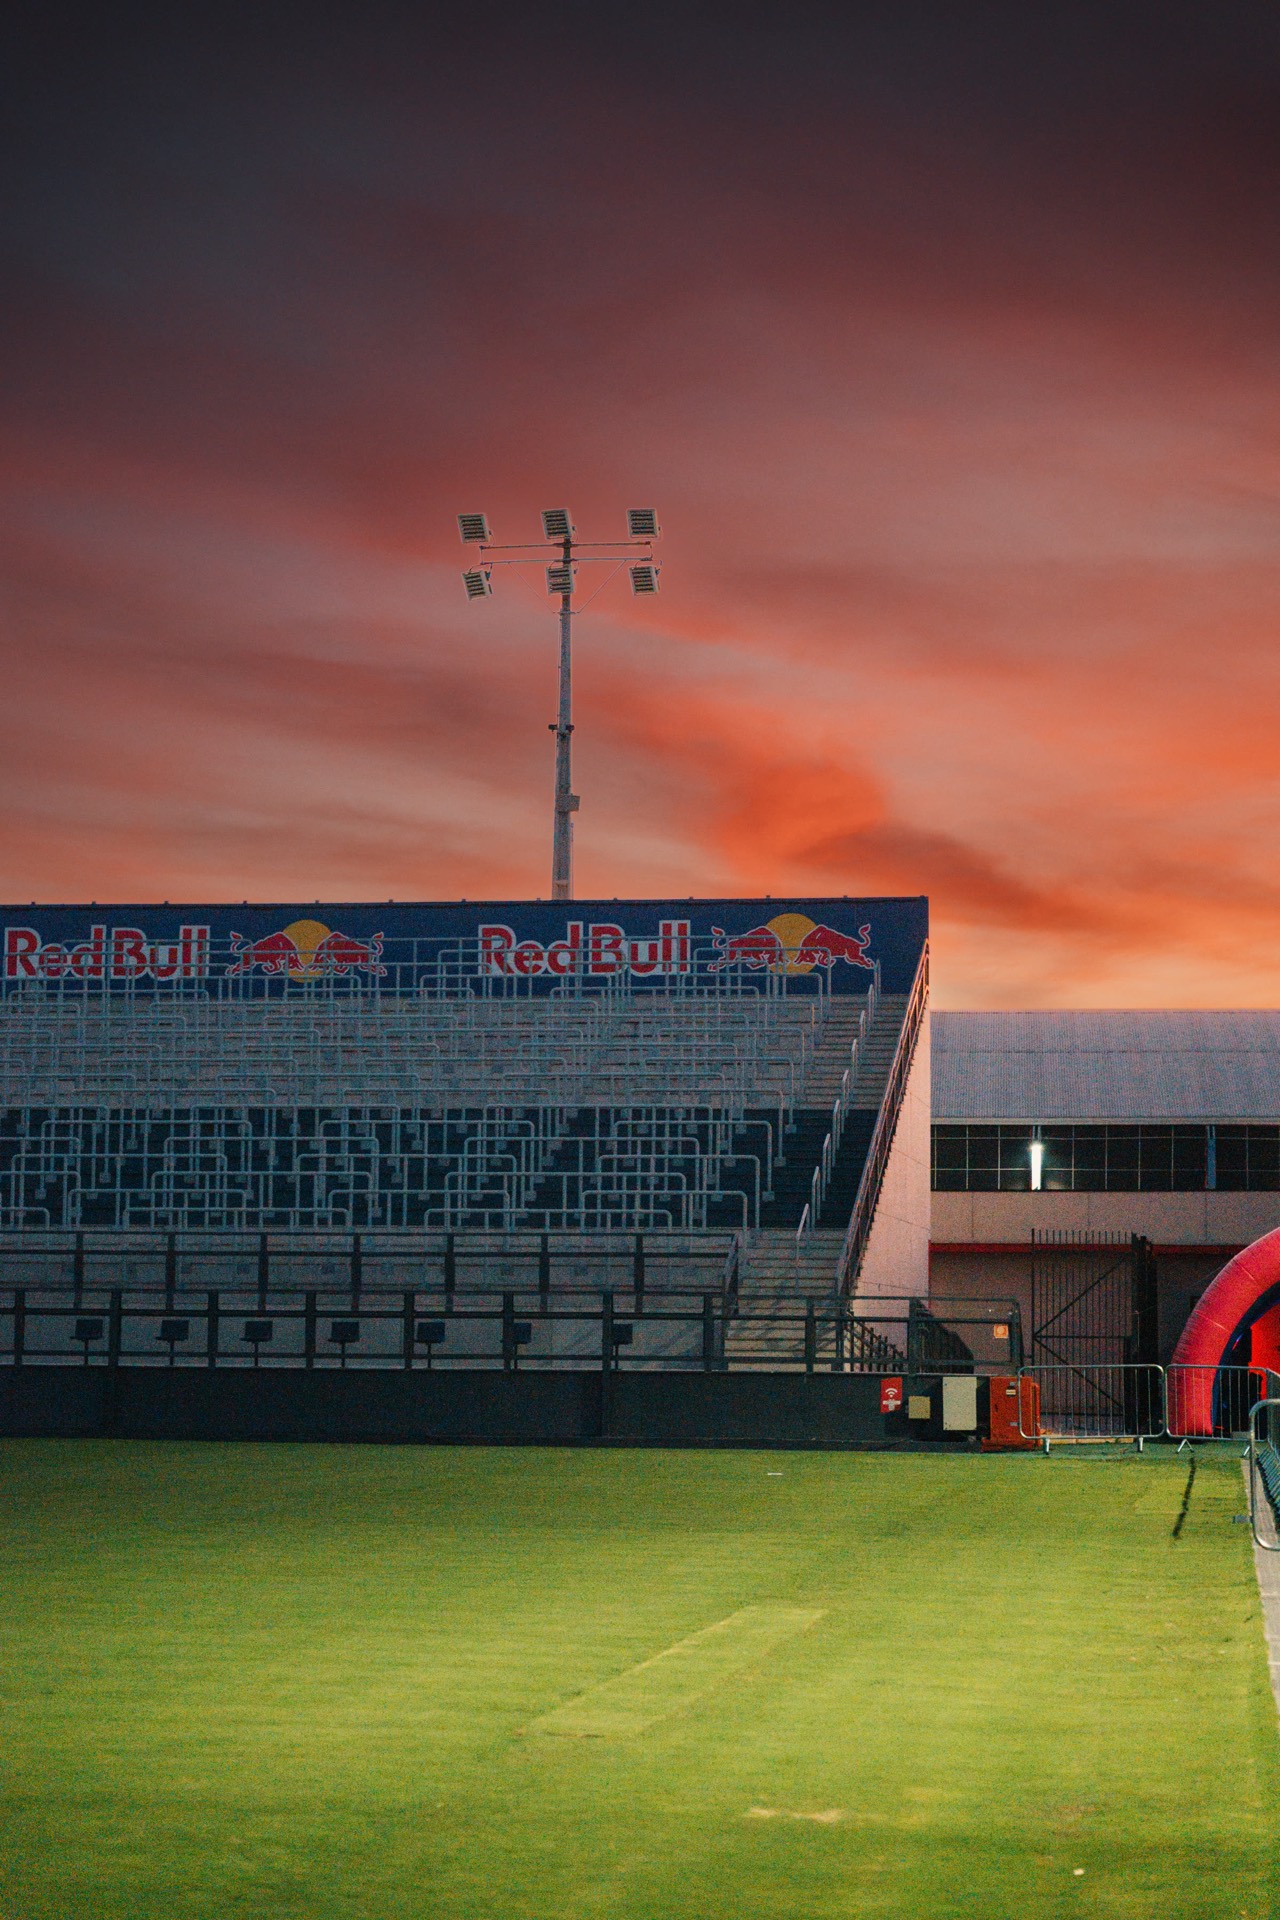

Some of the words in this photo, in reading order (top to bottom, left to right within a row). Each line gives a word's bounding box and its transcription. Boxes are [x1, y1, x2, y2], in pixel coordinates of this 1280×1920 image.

[5, 926, 106, 979] Red
[112, 926, 210, 980] Bull
[479, 921, 583, 975] Red
[589, 920, 690, 976] Bull
